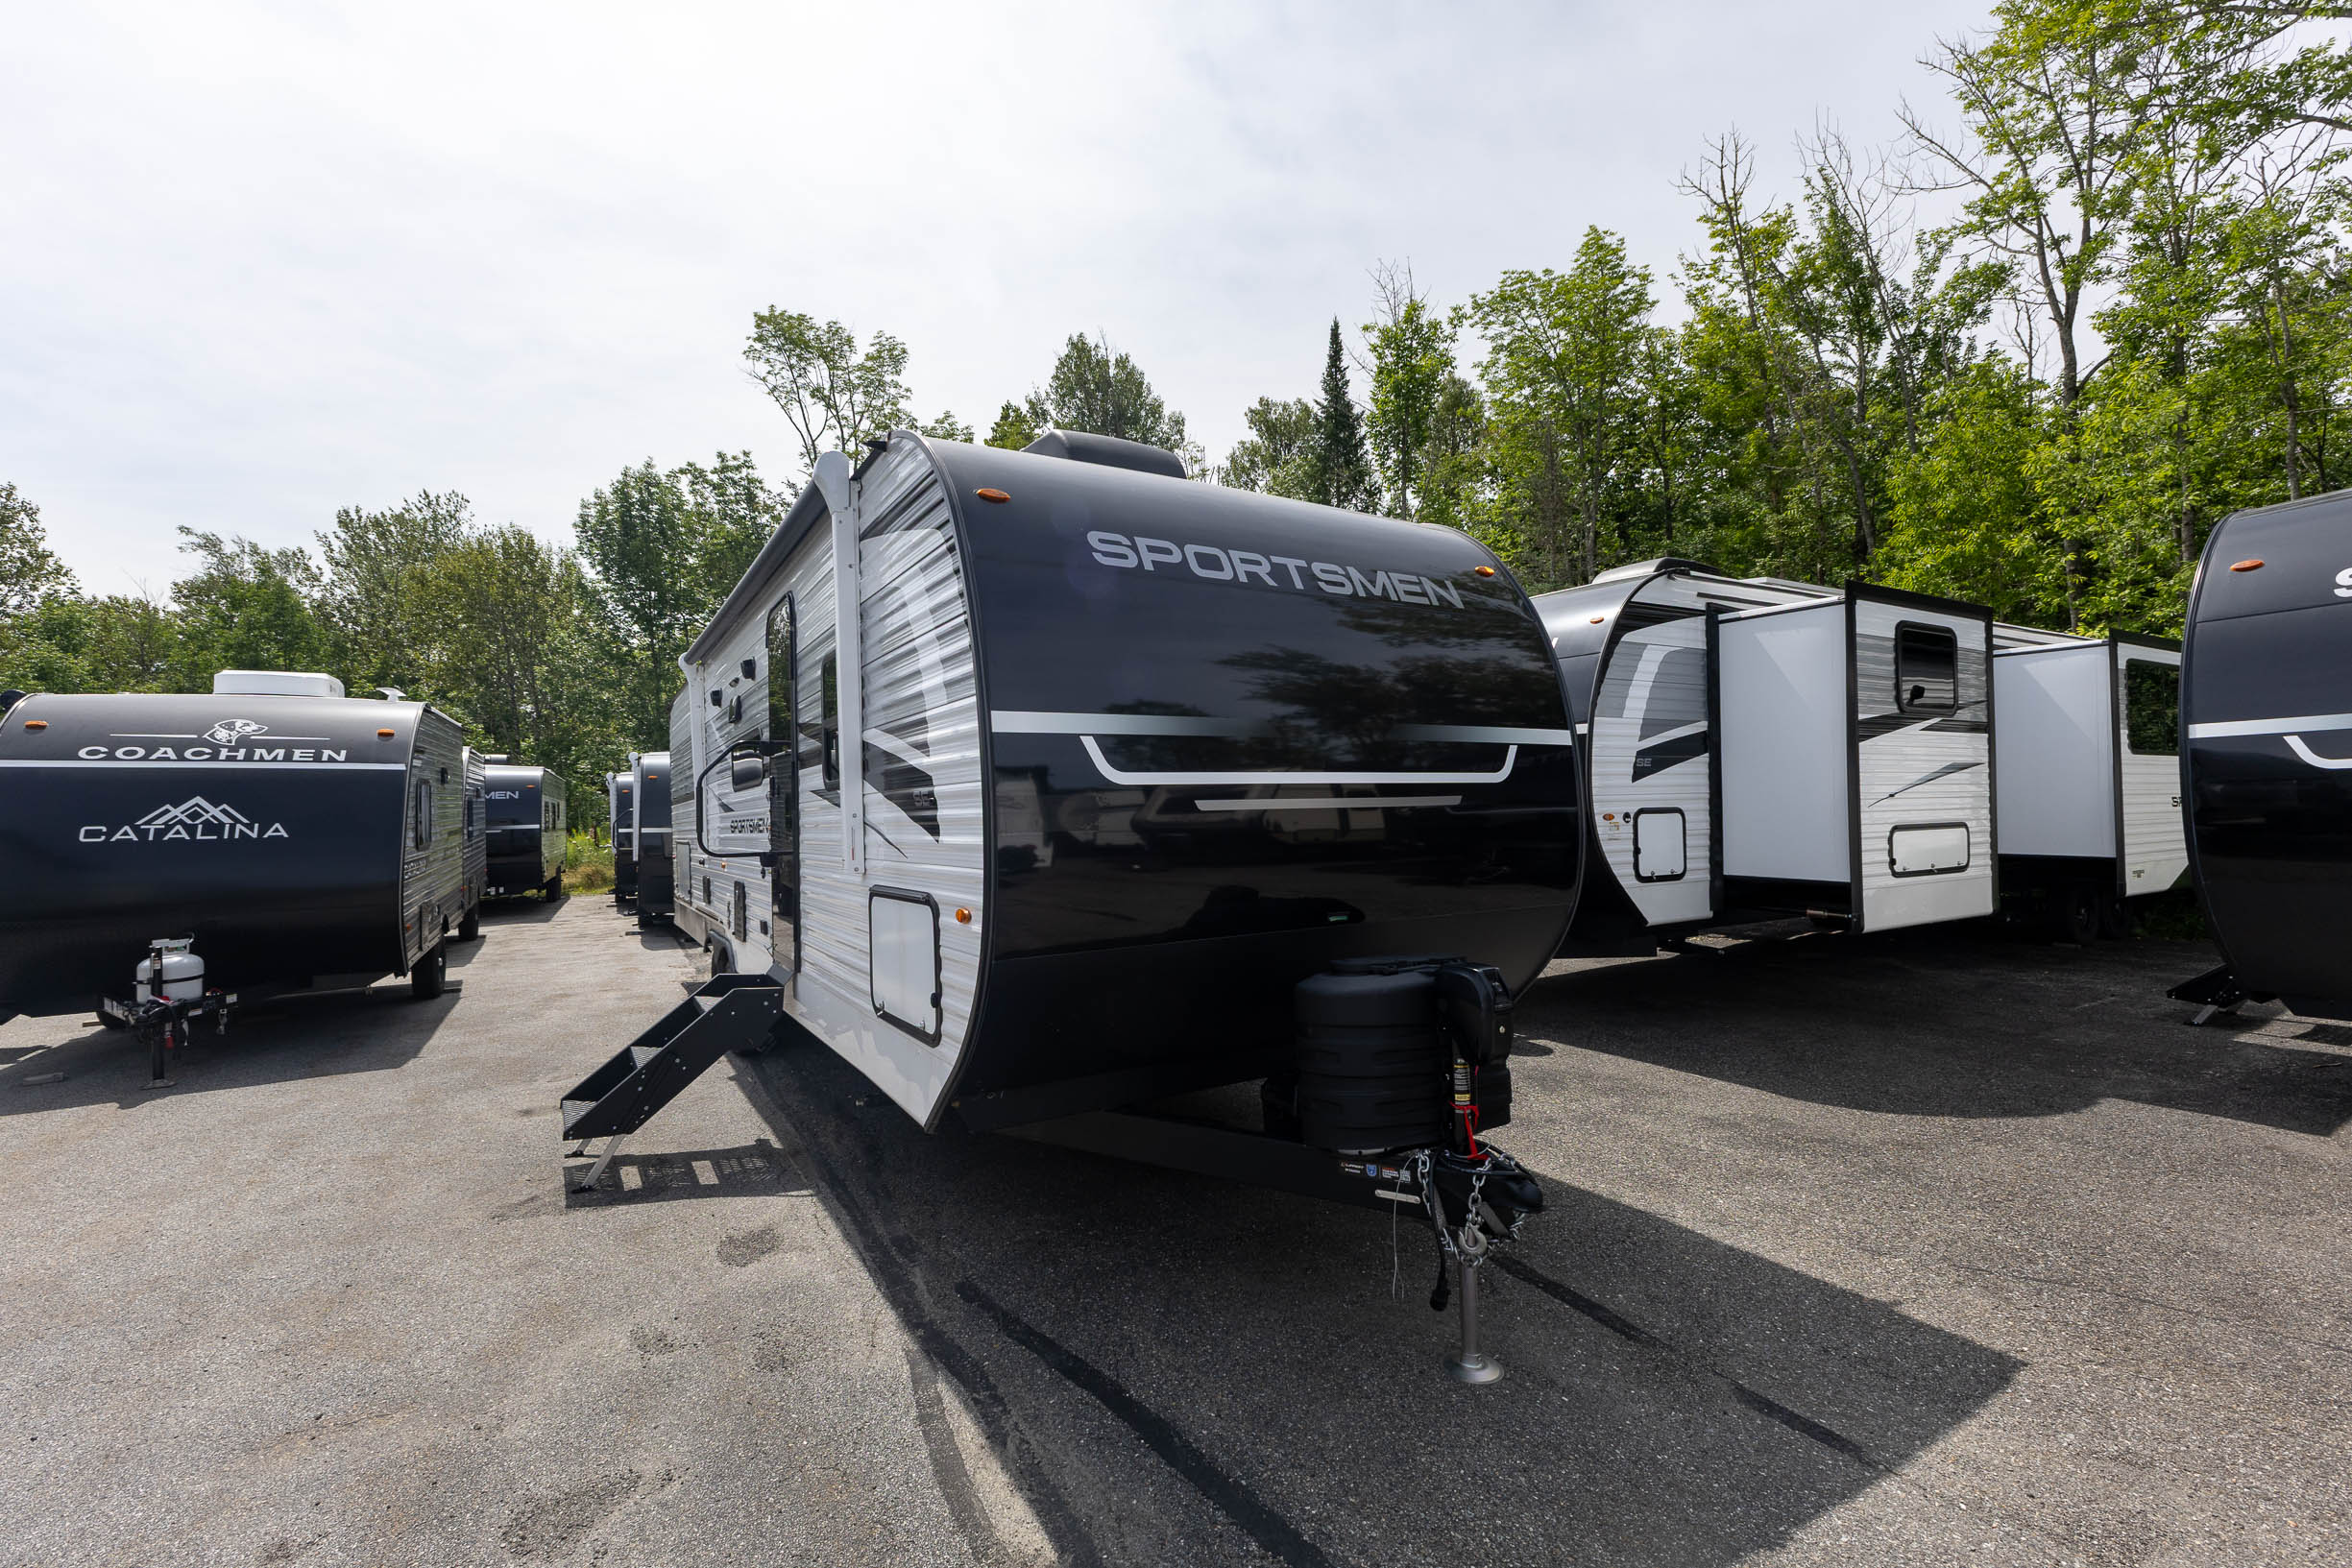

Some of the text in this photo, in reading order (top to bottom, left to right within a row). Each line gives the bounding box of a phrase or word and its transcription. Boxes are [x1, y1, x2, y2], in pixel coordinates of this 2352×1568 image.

[1086, 530, 1464, 609] SPORTSMEN
[77, 746, 348, 761] COACHMEN
[1636, 758, 1652, 767] SE
[79, 823, 289, 842] CATALINA
[730, 817, 769, 833] SPORTSMEN
